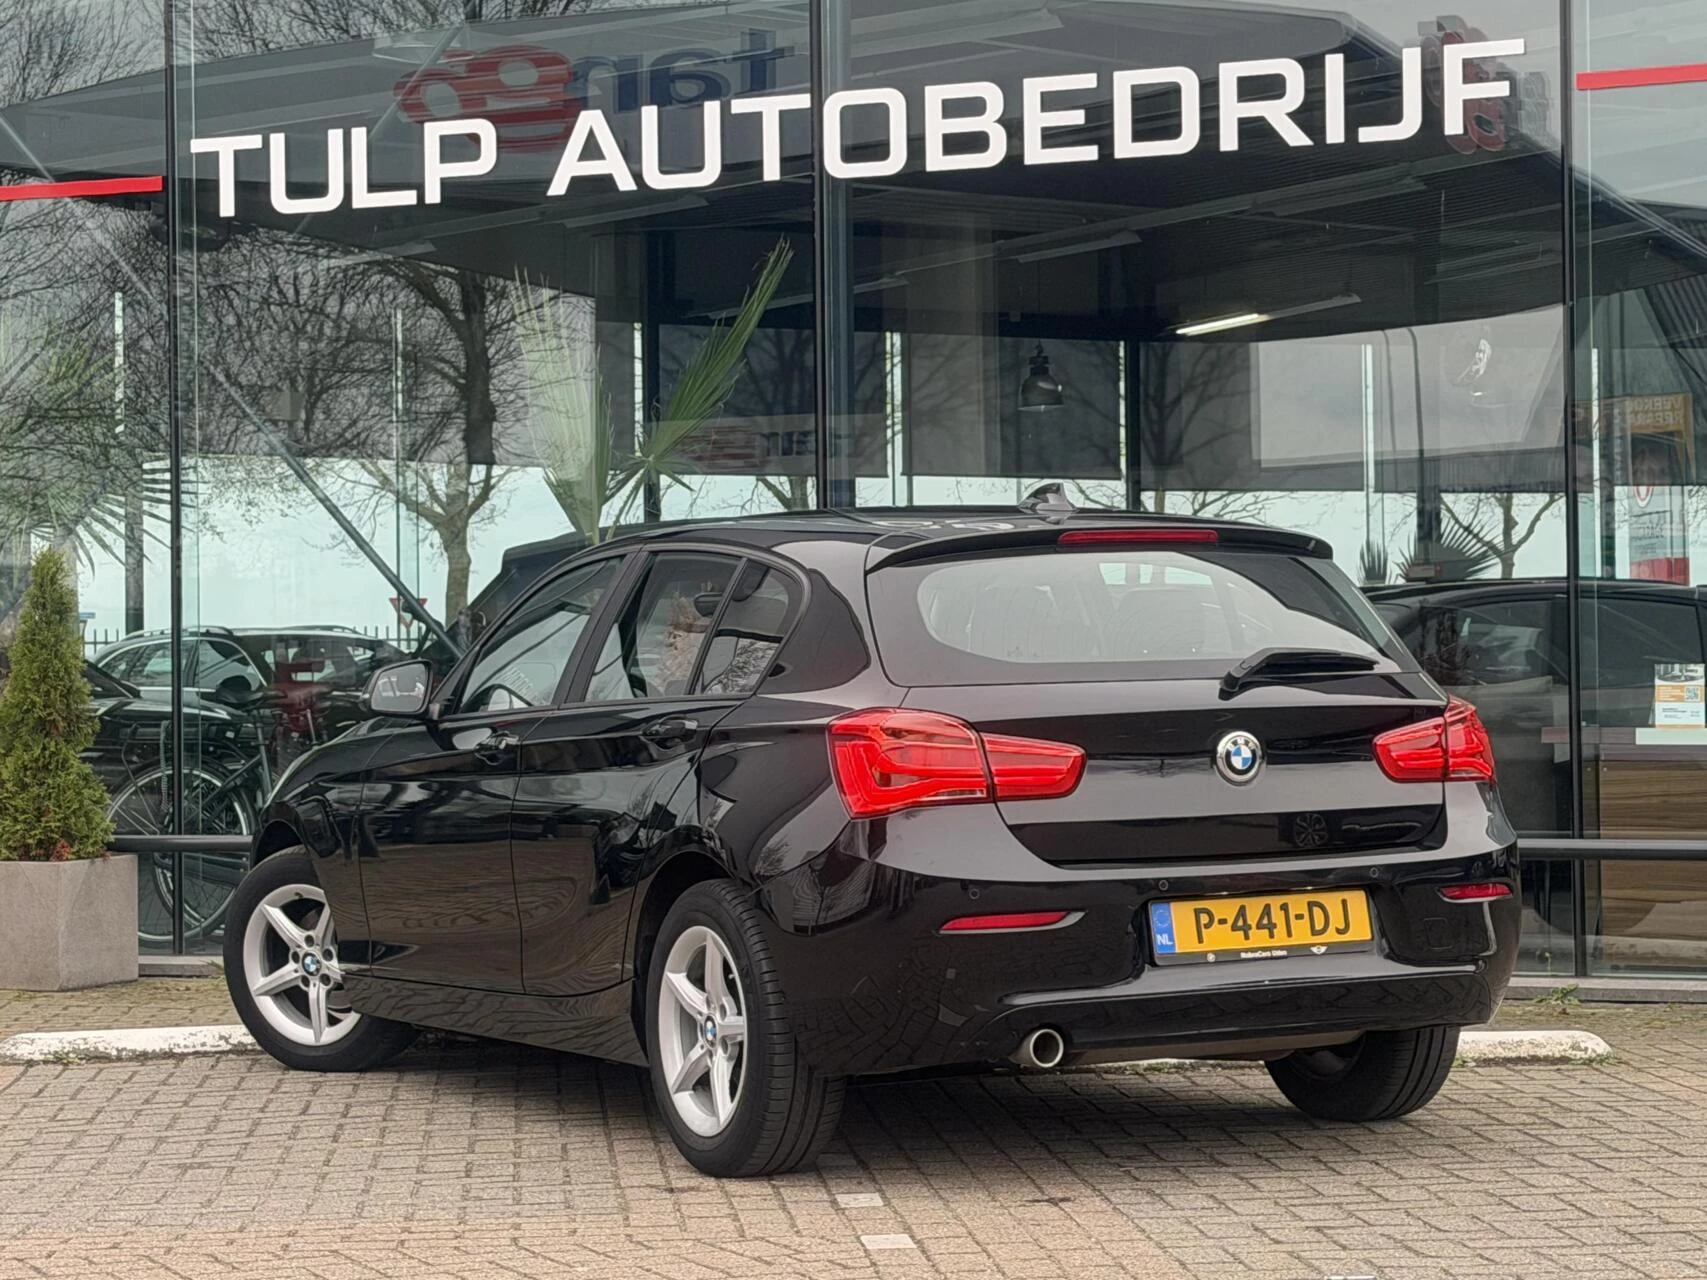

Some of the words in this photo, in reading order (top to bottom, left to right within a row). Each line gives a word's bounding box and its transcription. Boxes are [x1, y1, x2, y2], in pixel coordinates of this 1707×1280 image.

[190, 118, 498, 218] TULP
[546, 38, 1525, 197] AUTOBEDRIJF
[1157, 934, 1173, 946] NL
[1193, 898, 1351, 945] P-441-DJ
